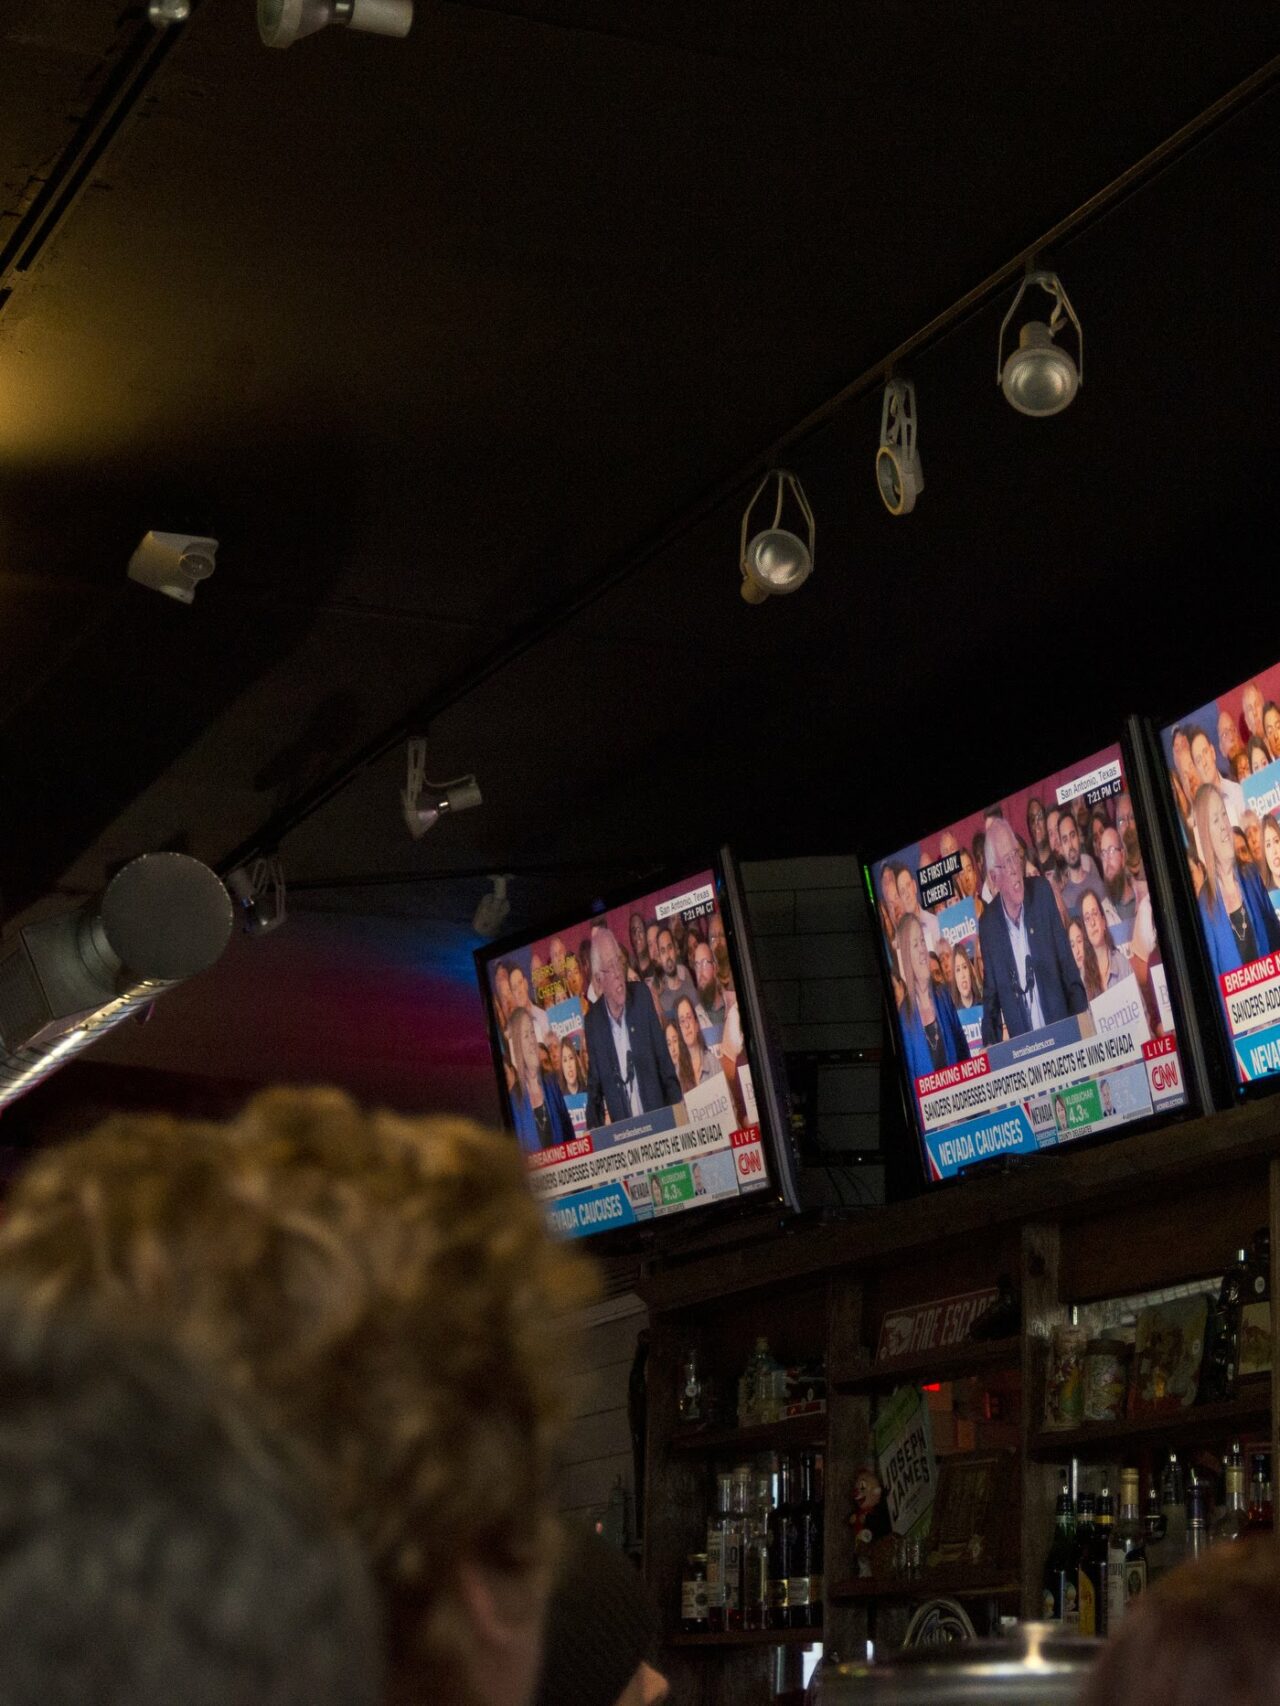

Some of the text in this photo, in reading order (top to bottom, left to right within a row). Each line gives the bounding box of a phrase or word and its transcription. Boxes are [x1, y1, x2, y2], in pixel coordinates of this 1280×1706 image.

[1061, 788, 1073, 800] San
[1098, 767, 1117, 781] Texas
[1101, 784, 1112, 798] PM
[1112, 780, 1121, 792] CT
[927, 862, 943, 880] FIRST
[1224, 957, 1274, 992] BREAKING
[1231, 996, 1266, 1024] SANDERS
[1147, 1038, 1172, 1057] LIVE
[919, 1059, 987, 1095] BREAKING NEWS
[924, 1098, 952, 1122] SANDERS
[952, 1083, 987, 1111] ADDRESSES
[1028, 1066, 1044, 1087] CNN
[1043, 1052, 1076, 1081] PROJECTS
[1076, 1049, 1087, 1068] HE
[1087, 1043, 1105, 1064] WINS
[1105, 1032, 1135, 1060] NEVADA
[1152, 1061, 1179, 1091] CNN
[567, 1138, 591, 1156] NEWS
[734, 1129, 756, 1146] LIVE
[939, 1138, 975, 1166] NEVADA
[975, 1118, 1024, 1156] CAUCUSES
[738, 1149, 761, 1175] CNN
[578, 1194, 623, 1226] CAUCUSES
[885, 1426, 926, 1492] JOSEPH
[893, 1458, 930, 1523] JAMES
